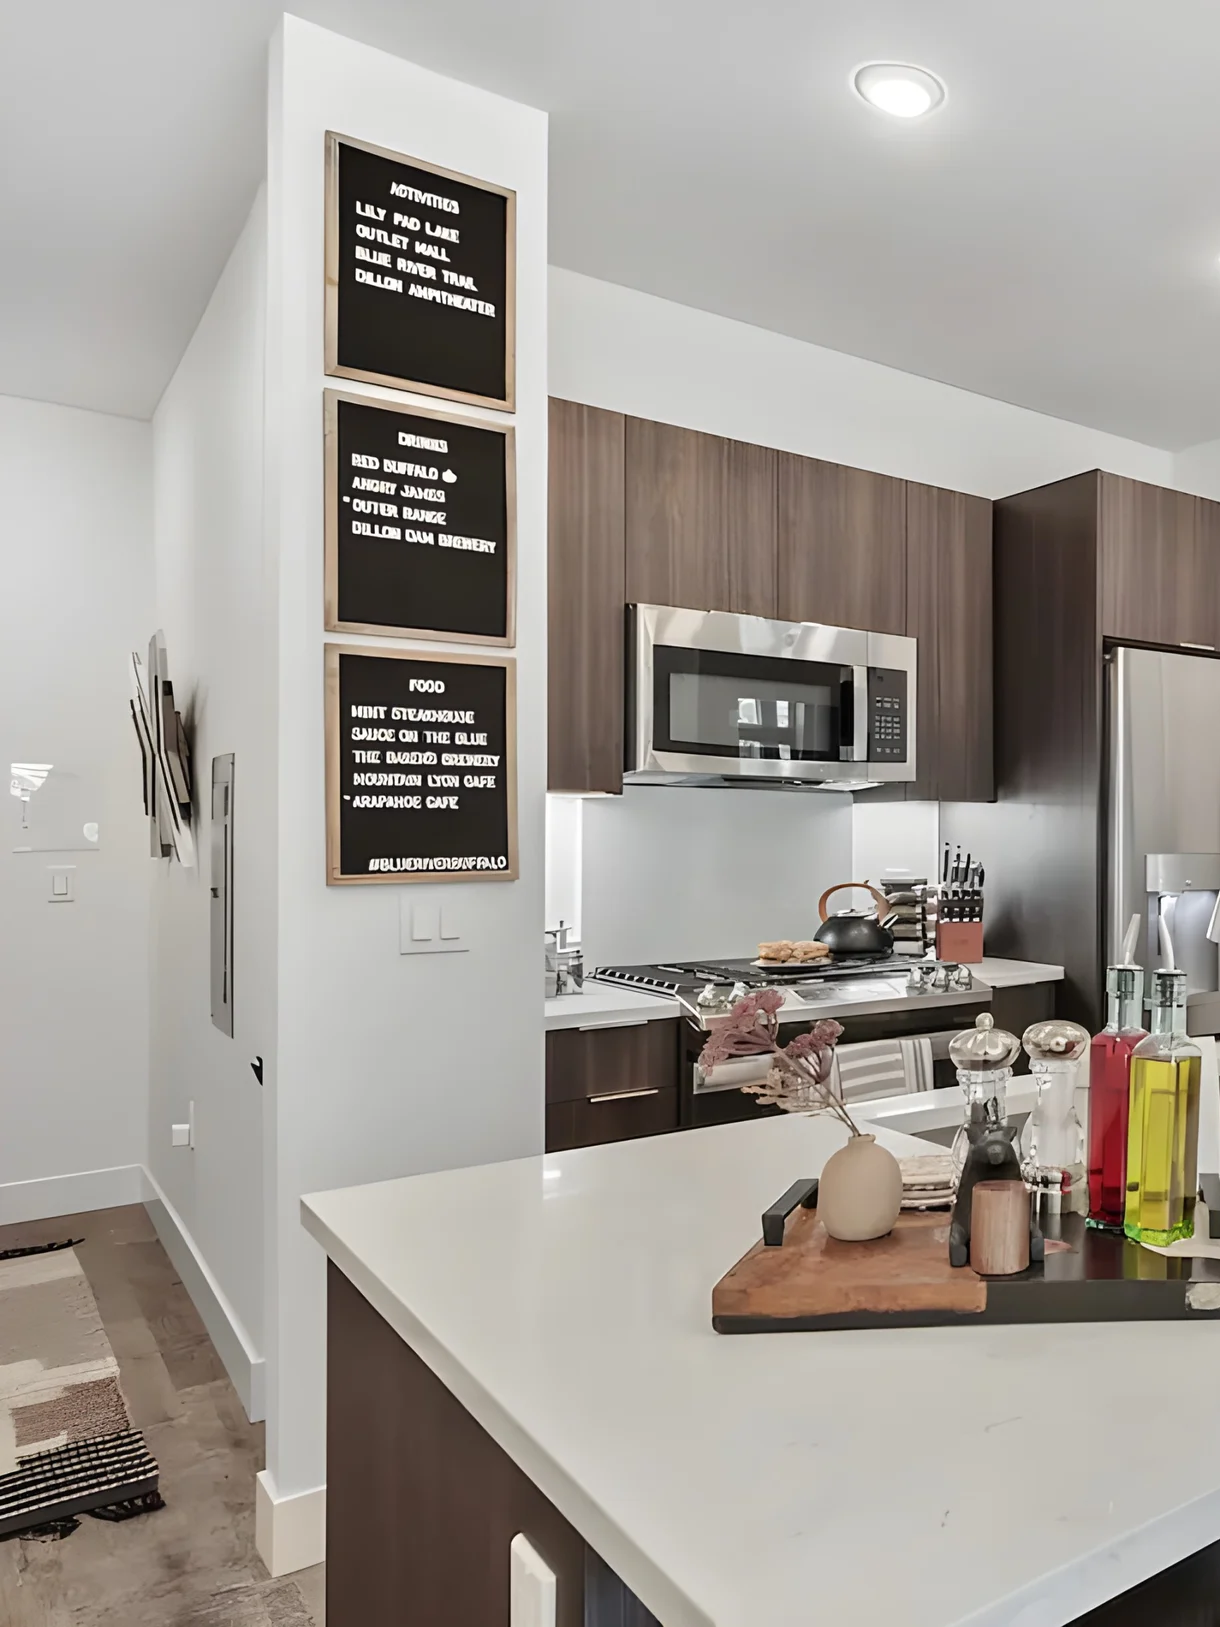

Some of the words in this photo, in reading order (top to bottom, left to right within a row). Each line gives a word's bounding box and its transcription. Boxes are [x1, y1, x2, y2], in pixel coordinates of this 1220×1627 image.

[355, 200, 387, 222] LILY
[393, 212, 421, 232] PAD
[424, 221, 460, 244] LAKE
[355, 223, 410, 250] OUTLET
[414, 240, 451, 263] MALL
[354, 245, 392, 268] BLUE
[396, 257, 437, 281] RIVER
[441, 269, 479, 292] TRAIL
[354, 267, 403, 293] DILLON
[351, 453, 380, 470] RED
[383, 458, 438, 481] BUFFALO
[351, 476, 398, 496] ANGRY
[399, 484, 446, 503] JAMES
[352, 498, 399, 519] OUTER
[351, 520, 402, 541] DILLON
[405, 529, 434, 546] DAM
[408, 678, 446, 694] FOOD
[398, 729, 419, 743] ON
[422, 730, 451, 745] THE
[454, 731, 488, 746] BLUE
[351, 749, 381, 764] THE
[463, 774, 497, 789] CAFE
[425, 795, 460, 810] CAFE
